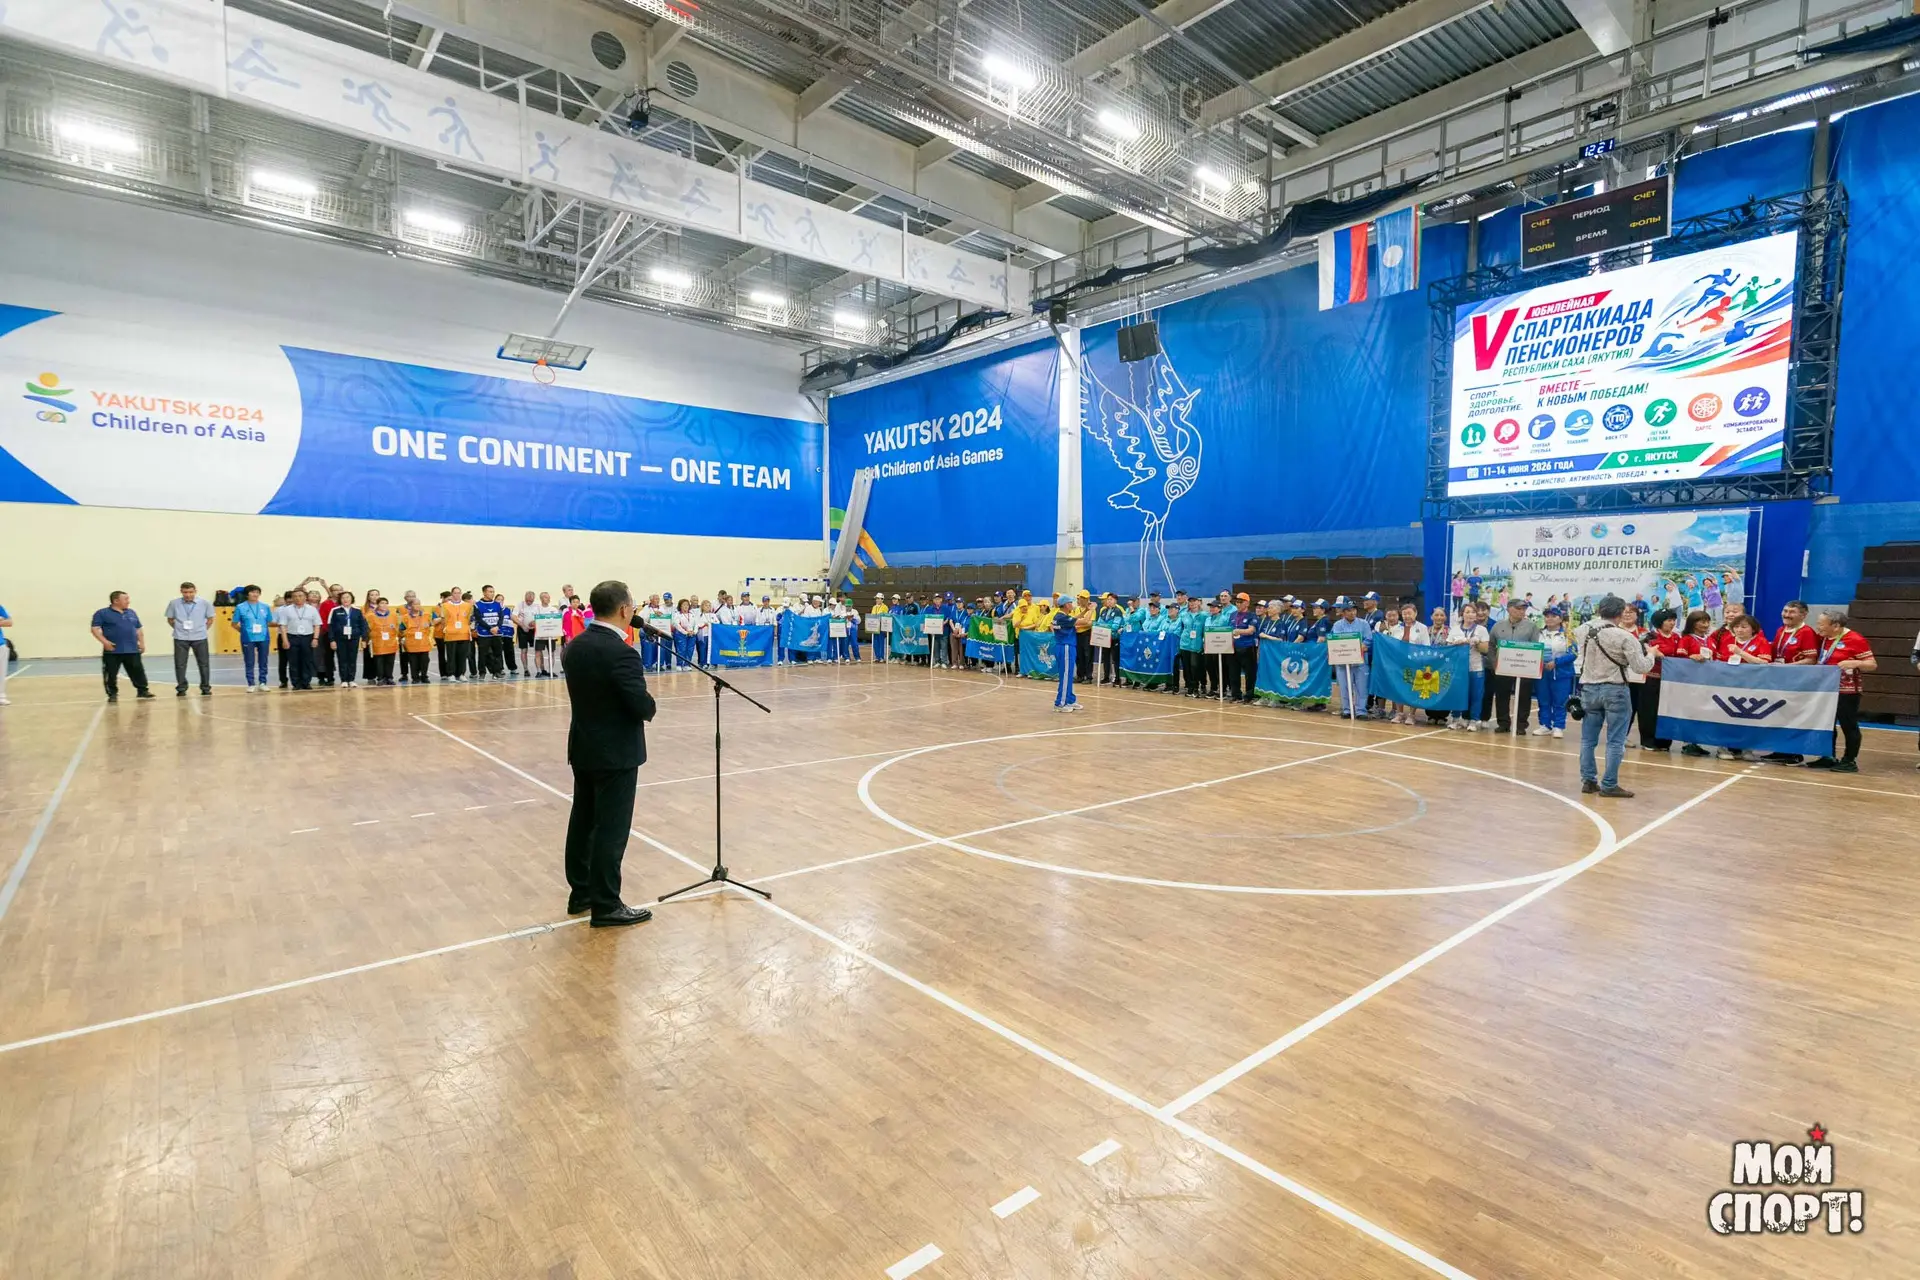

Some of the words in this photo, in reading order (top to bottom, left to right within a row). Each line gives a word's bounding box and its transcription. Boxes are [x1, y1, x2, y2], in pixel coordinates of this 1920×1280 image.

[1572, 204, 1611, 220] ПЕРИОД
[1629, 215, 1661, 228] ФОЛЫ
[1527, 242, 1556, 253] ФОЛЫ
[1575, 229, 1608, 242] ВРЕМЯ
[1531, 295, 1595, 318] ЮБИЛЕЙНАЯ
[1512, 298, 1653, 343] СПАРТАКИАДА
[1472, 307, 1520, 372] V
[1504, 323, 1645, 366] ПЕНСИОНЕРОВ
[1502, 360, 1559, 378] РЕСПУБЛИКИ
[1561, 356, 1585, 368] САХА
[1587, 347, 1634, 365] (ЯКУТИЯ)
[1536, 398, 1544, 408] К
[1546, 391, 1587, 407] НОВЫМ
[1590, 383, 1649, 401] ПОБЕДАМ!
[1539, 380, 1581, 395] ВМЕСТЕ
[90, 391, 203, 417] YAKUTSK
[208, 404, 264, 423] 2024
[92, 412, 187, 436] Children
[194, 420, 215, 437] of
[221, 425, 265, 442] Asia
[864, 417, 945, 454] YAKUTSK
[949, 405, 1003, 440] 2024
[372, 426, 447, 461] ONE
[458, 435, 632, 477] CONTINENT
[671, 457, 721, 485] ONE
[728, 463, 790, 490] TEAM
[882, 461, 921, 478] Children
[923, 456, 935, 471] of
[936, 453, 960, 470] Asia
[962, 447, 1003, 466] Games
[1531, 461, 1551, 472] 2026
[1554, 460, 1574, 470] ГОДА
[1644, 451, 1678, 461] ЯКУТСК
[1517, 548, 1530, 558] ОТ
[1532, 547, 1595, 558] ЗДОРОВОГО
[1597, 545, 1651, 557] ДЕТСТВА
[1512, 562, 1519, 571] К
[1521, 561, 1581, 571] АКТИВНОМУ
[1583, 559, 1663, 570] ДОЛГОЛЕТИЮ!
